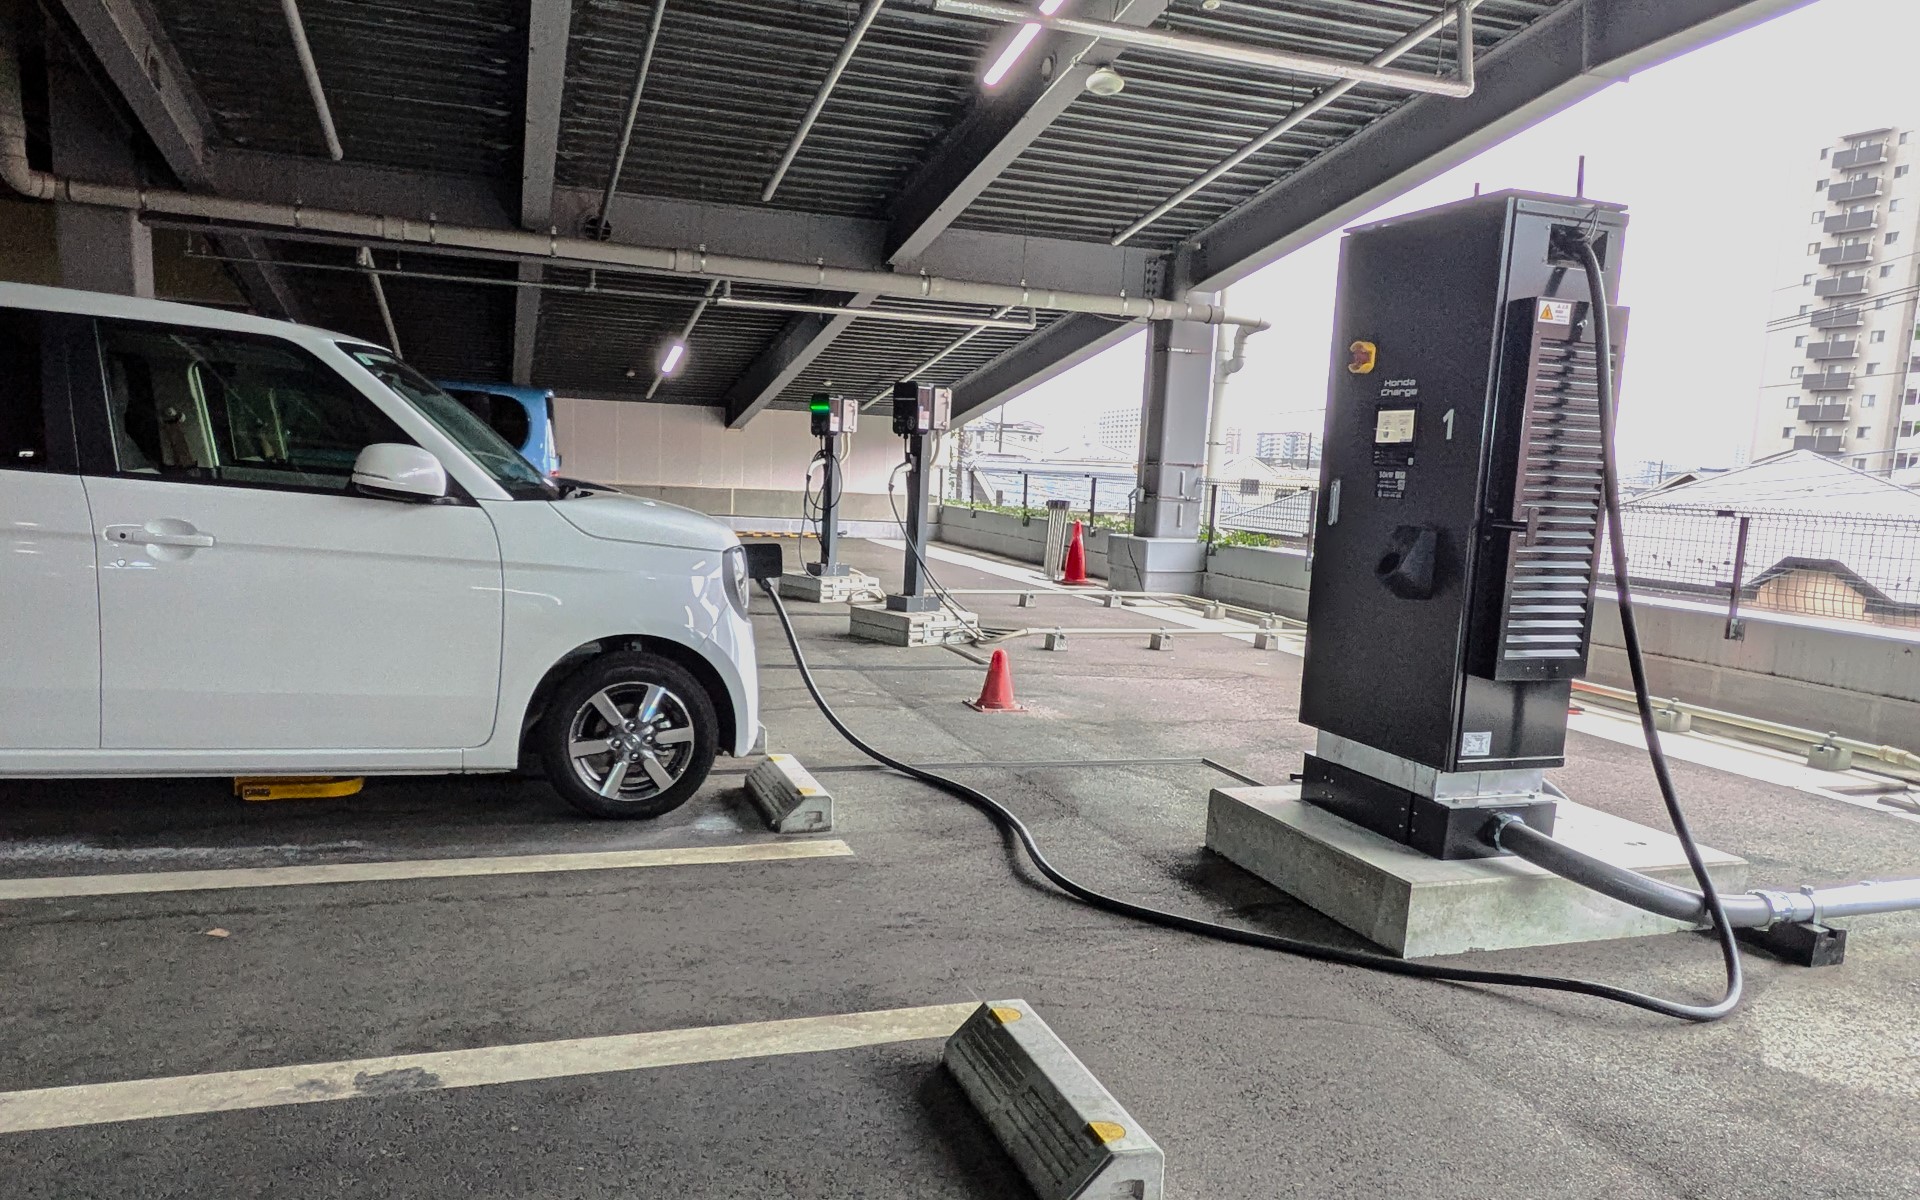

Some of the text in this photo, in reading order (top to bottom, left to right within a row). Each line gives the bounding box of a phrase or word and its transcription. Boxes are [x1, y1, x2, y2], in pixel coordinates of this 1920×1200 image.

[1384, 379, 1416, 387] Honda
[1381, 388, 1418, 397] Charge
[1442, 408, 1455, 440] 1
